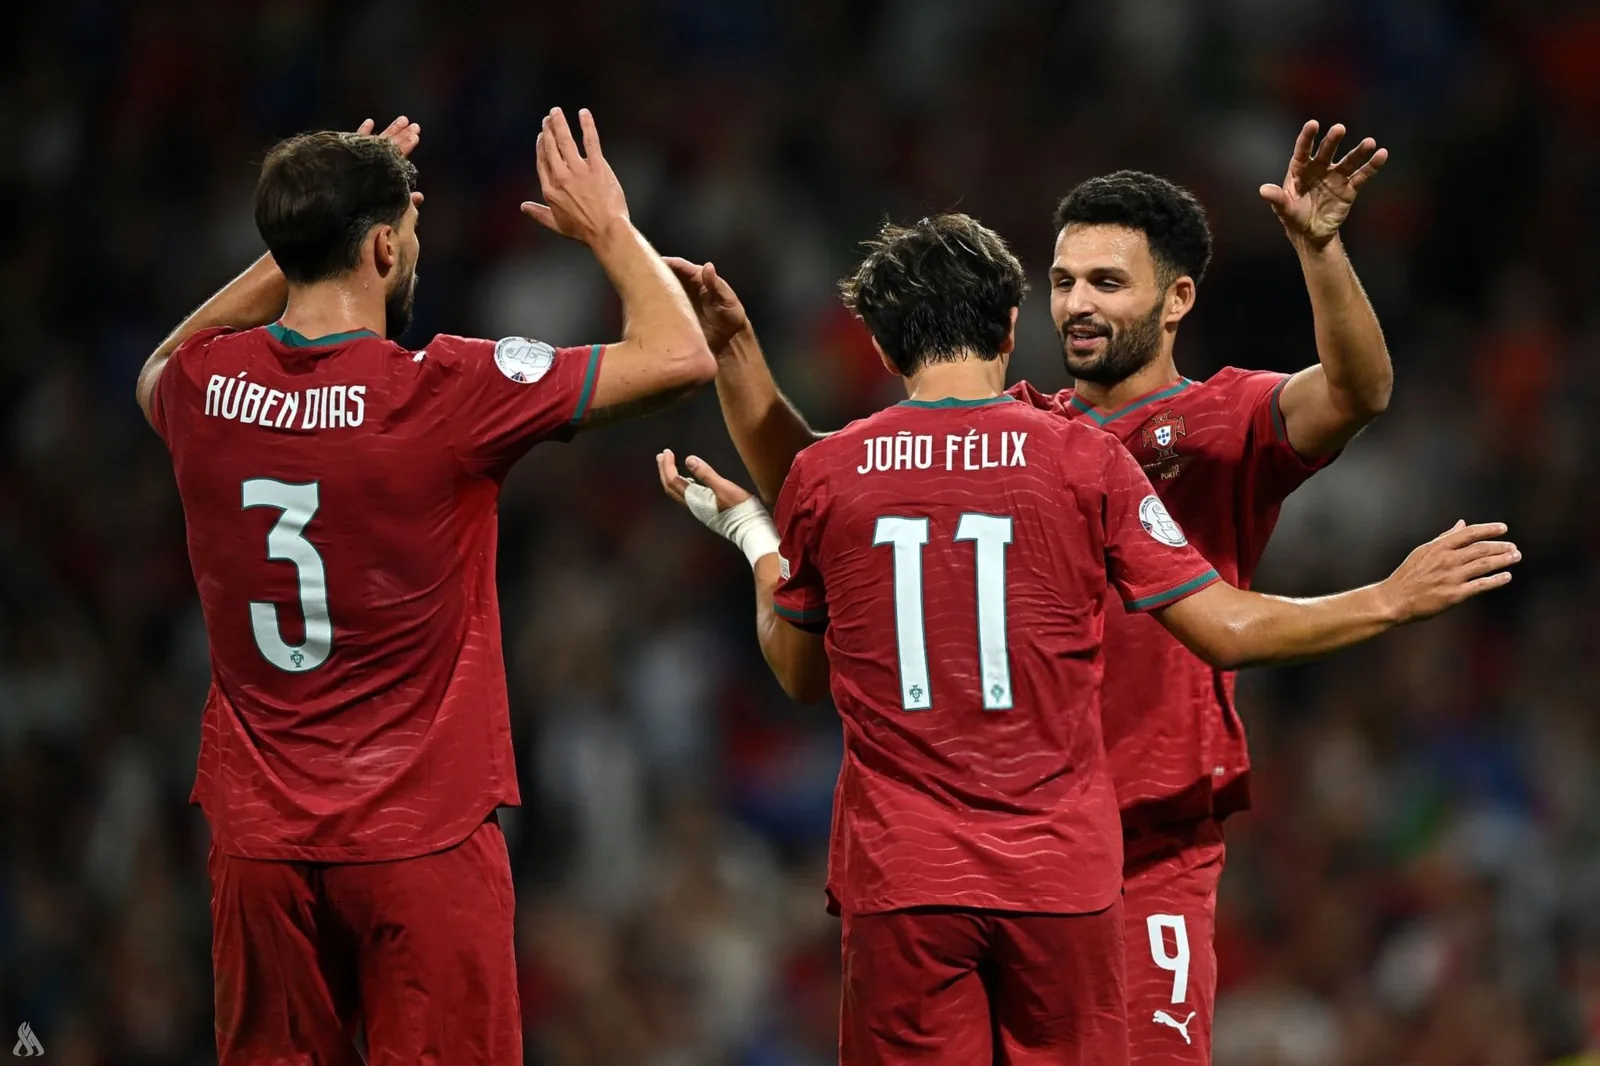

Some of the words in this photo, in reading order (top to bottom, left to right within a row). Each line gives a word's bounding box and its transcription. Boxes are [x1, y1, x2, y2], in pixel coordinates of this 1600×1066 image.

[204, 371, 300, 429] RÚBEN
[301, 385, 367, 430] DIAS
[856, 430, 933, 475] JOÃO
[945, 428, 1028, 471] FÉLIX
[241, 476, 334, 674] 3
[872, 512, 1014, 712] 11
[1146, 913, 1191, 1004] 9
